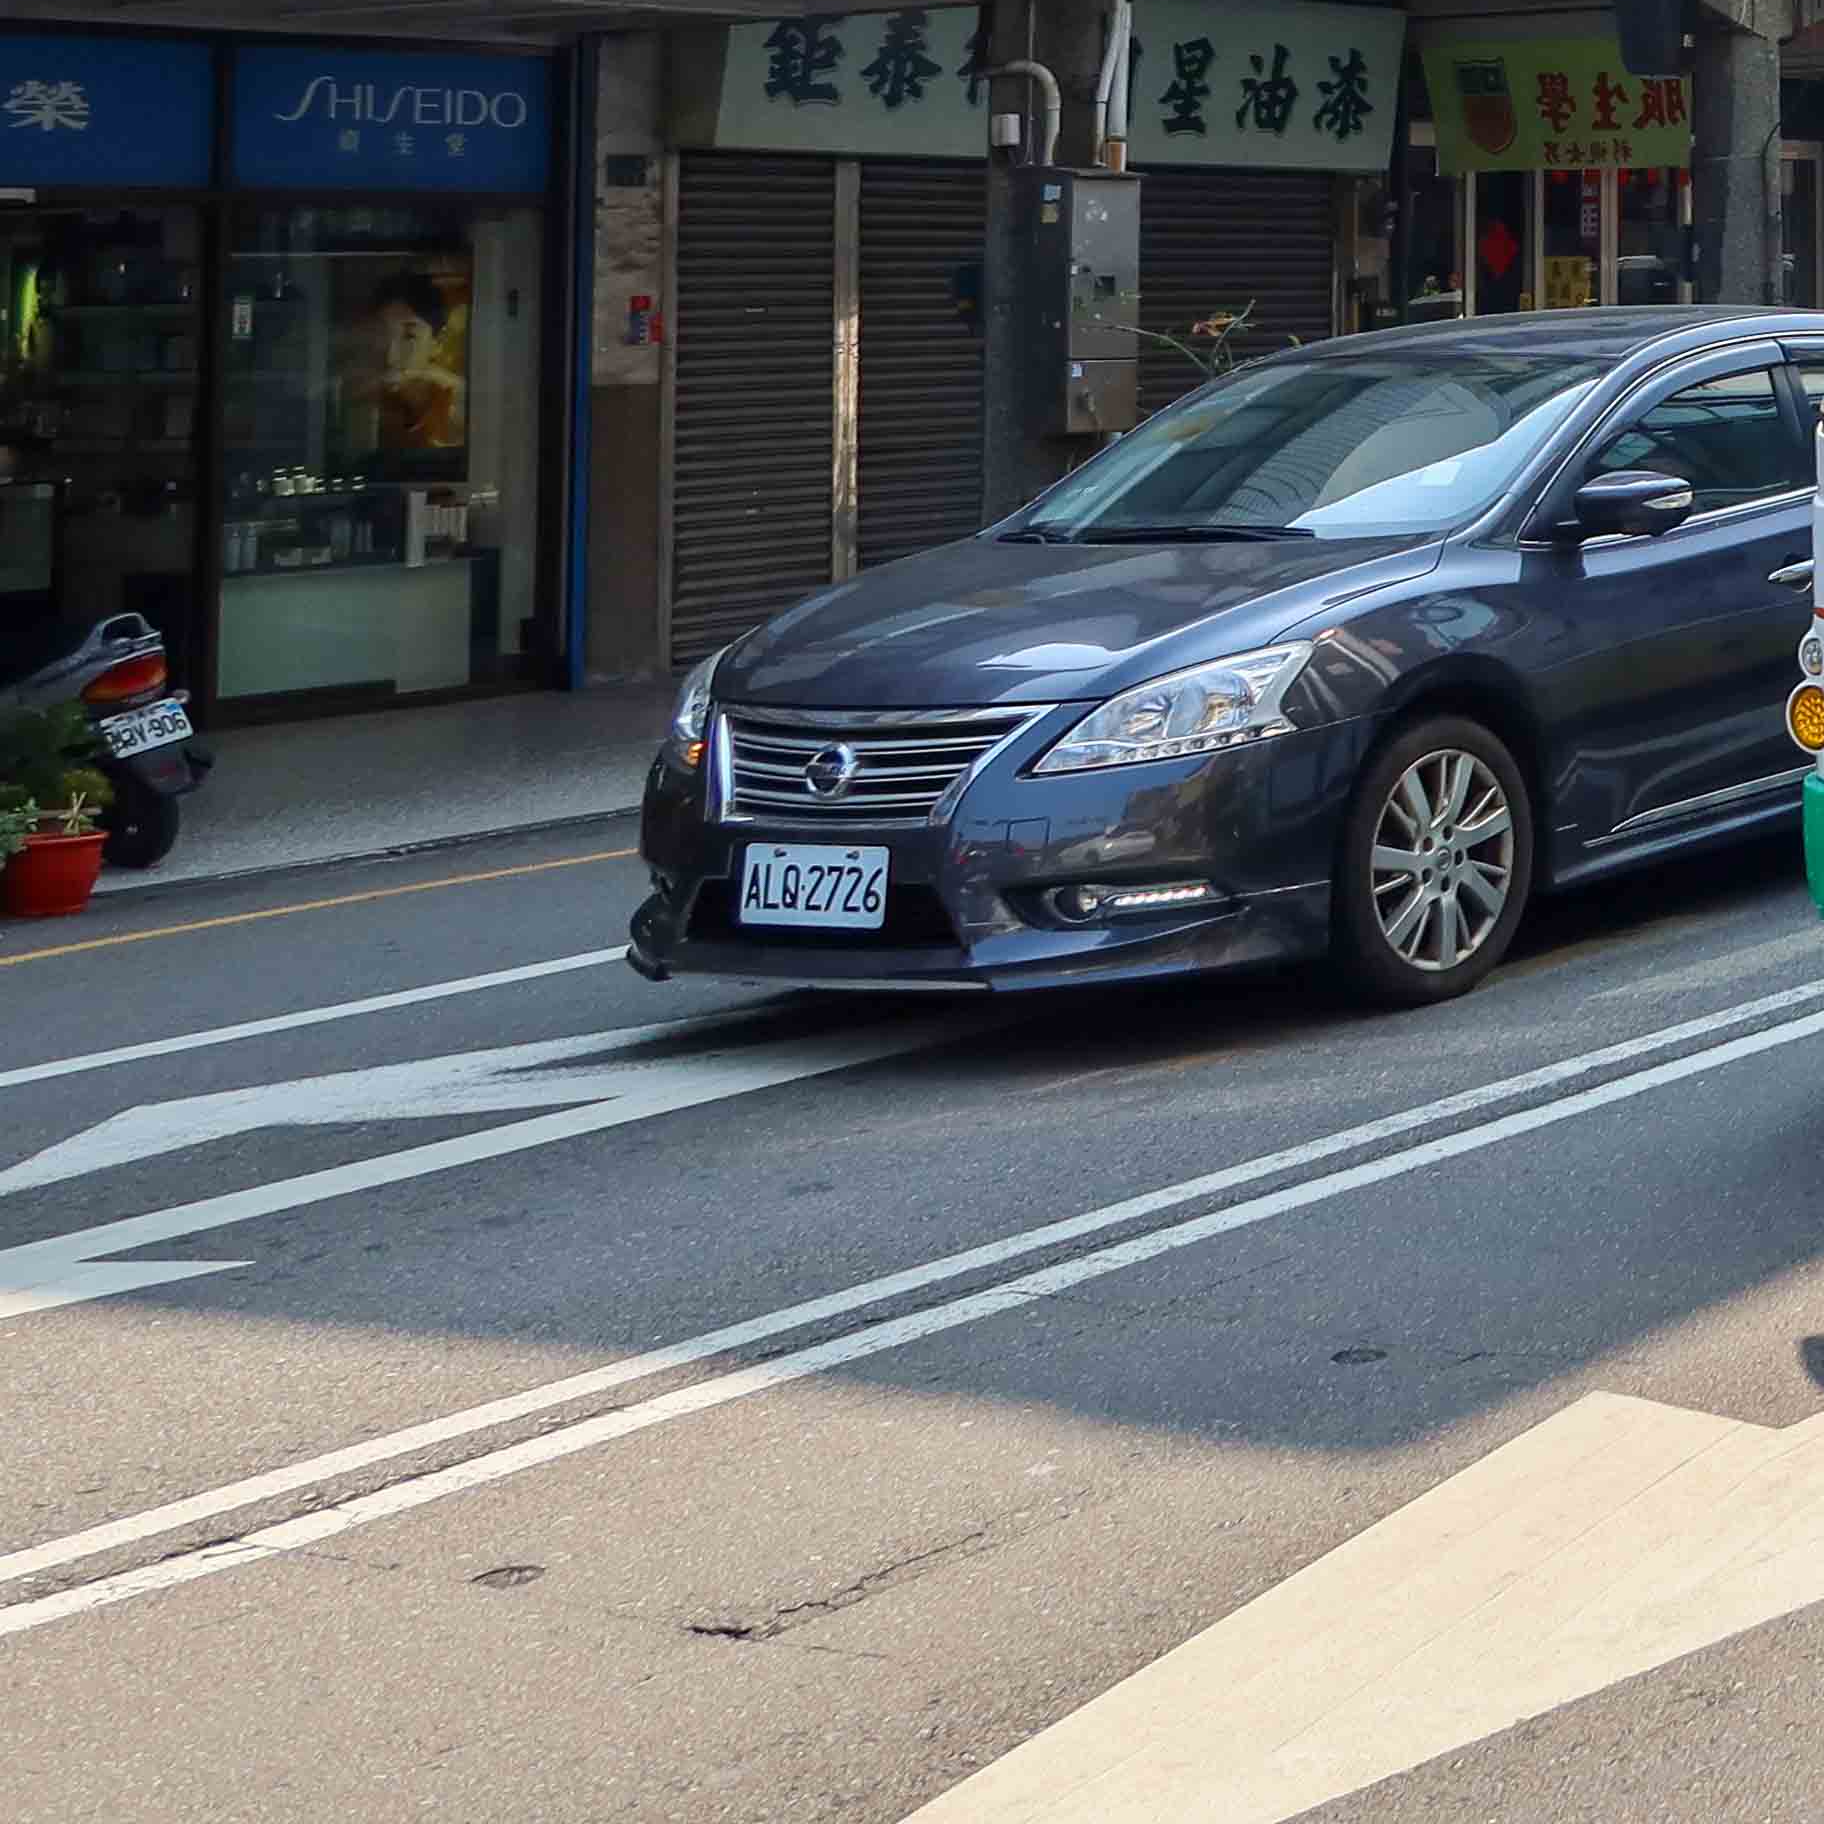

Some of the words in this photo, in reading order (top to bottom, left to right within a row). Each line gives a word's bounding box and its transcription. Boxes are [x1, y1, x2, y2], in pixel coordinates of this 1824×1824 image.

[274, 75, 528, 129] SHISEIDO
[762, 12, 990, 109] 鉅泰
[1130, 36, 1374, 142] 星油漆
[2, 79, 90, 131] 榮
